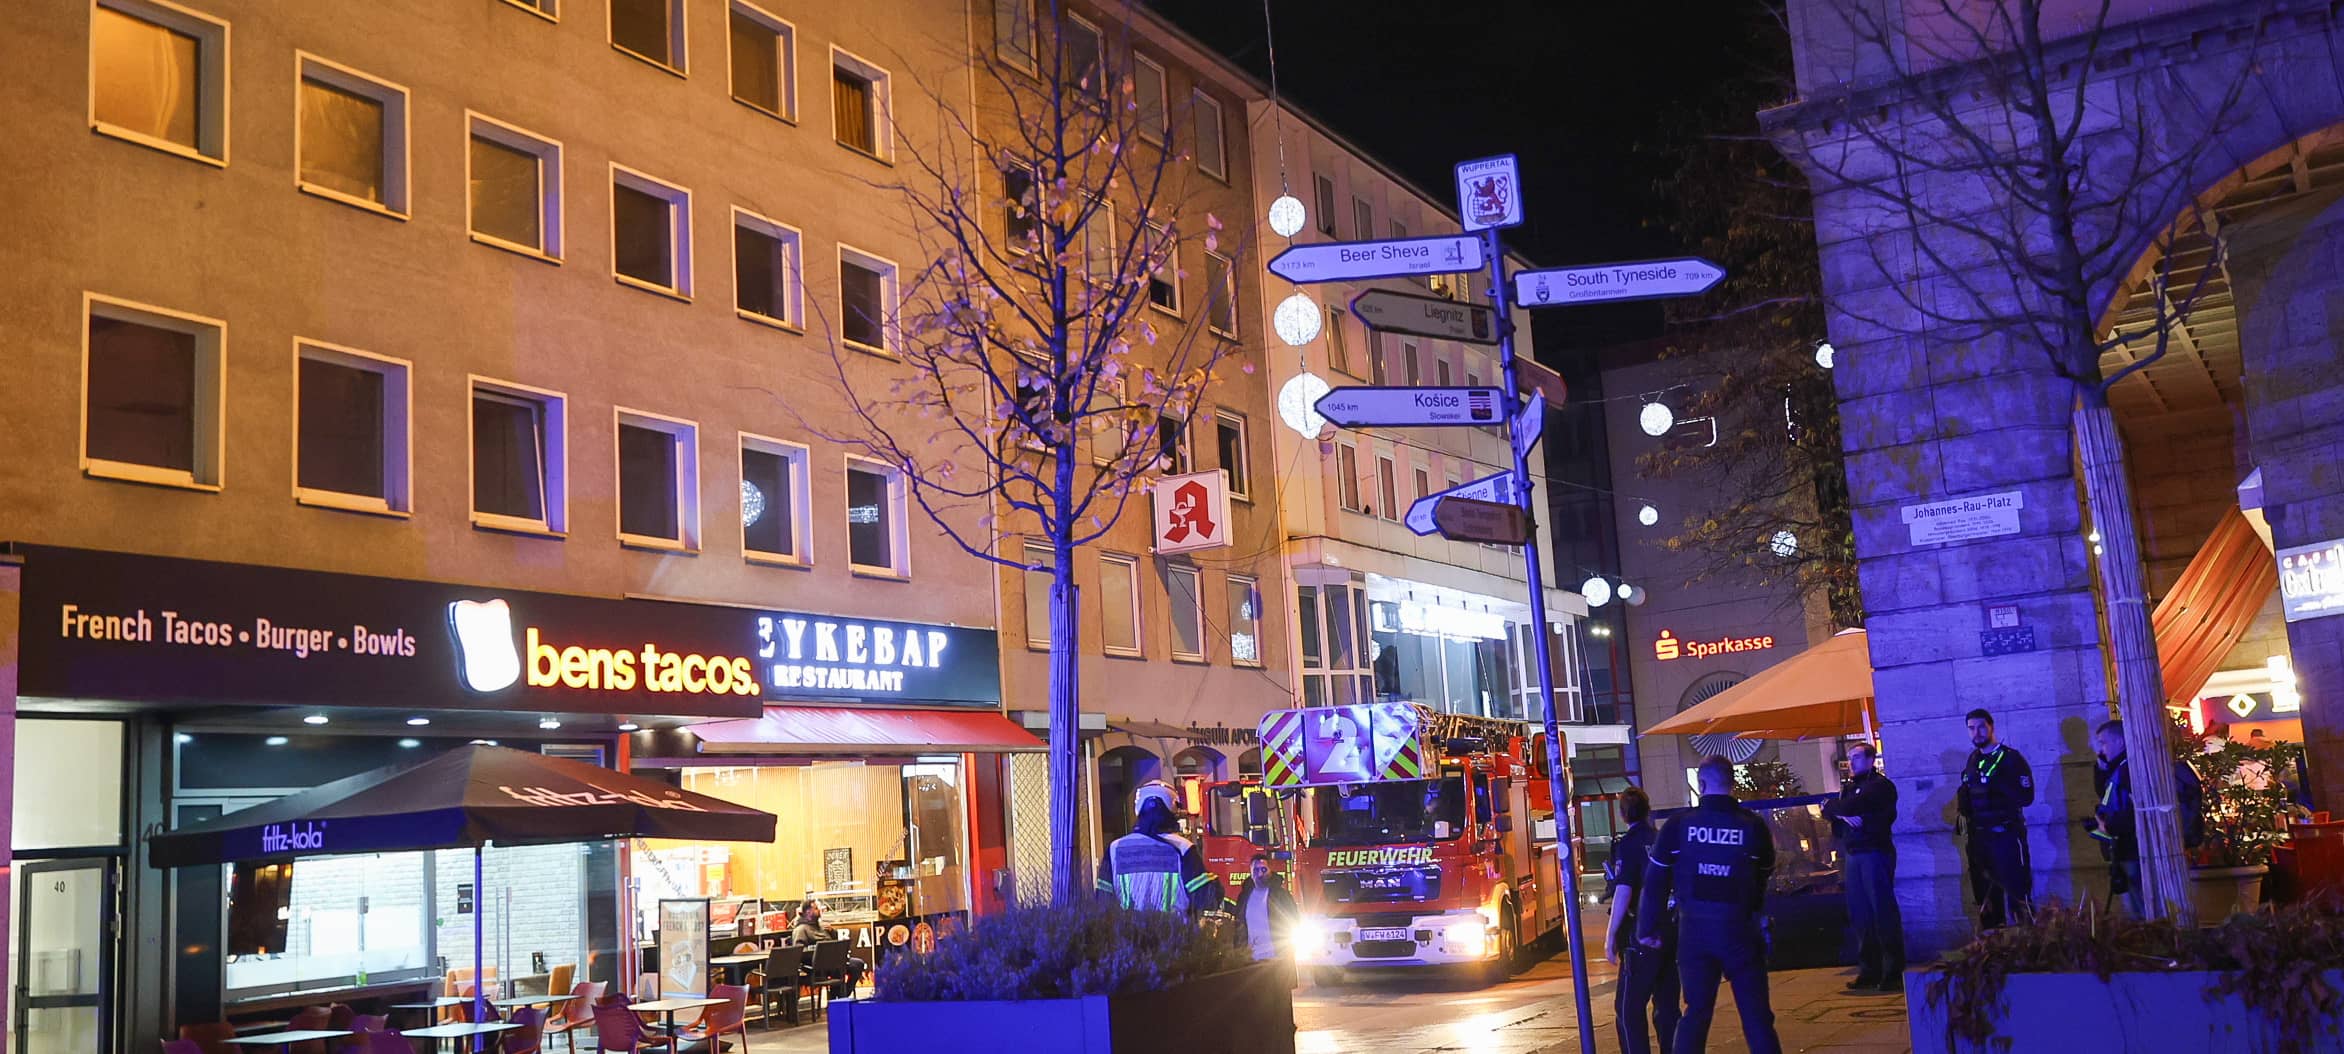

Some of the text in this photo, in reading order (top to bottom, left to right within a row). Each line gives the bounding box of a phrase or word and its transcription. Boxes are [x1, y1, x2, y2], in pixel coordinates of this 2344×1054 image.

[1461, 160, 1509, 173] WUPPERTAL
[1340, 245, 1429, 262] Beer Sheva
[1567, 267, 1677, 286] South Tyneside
[1424, 304, 1464, 323] Liegnitz
[1327, 403, 1359, 412] 1045 km
[1414, 393, 1459, 408] Košice
[1913, 497, 2011, 519] Johannes-Rau-Platz
[61, 604, 416, 659] French Tacos Burger Bowls
[1687, 636, 1773, 659] Sparkasse
[526, 627, 761, 696] bens tacos.
[773, 665, 904, 691] RESTAURANT
[262, 821, 323, 853] fritz-kola
[1687, 826, 1744, 845] POLIZEI
[1327, 847, 1433, 867] FEUERWEHR
[1698, 863, 1731, 876] NRW
[54, 881, 66, 893] 40
[1360, 877, 1401, 889] MAN
